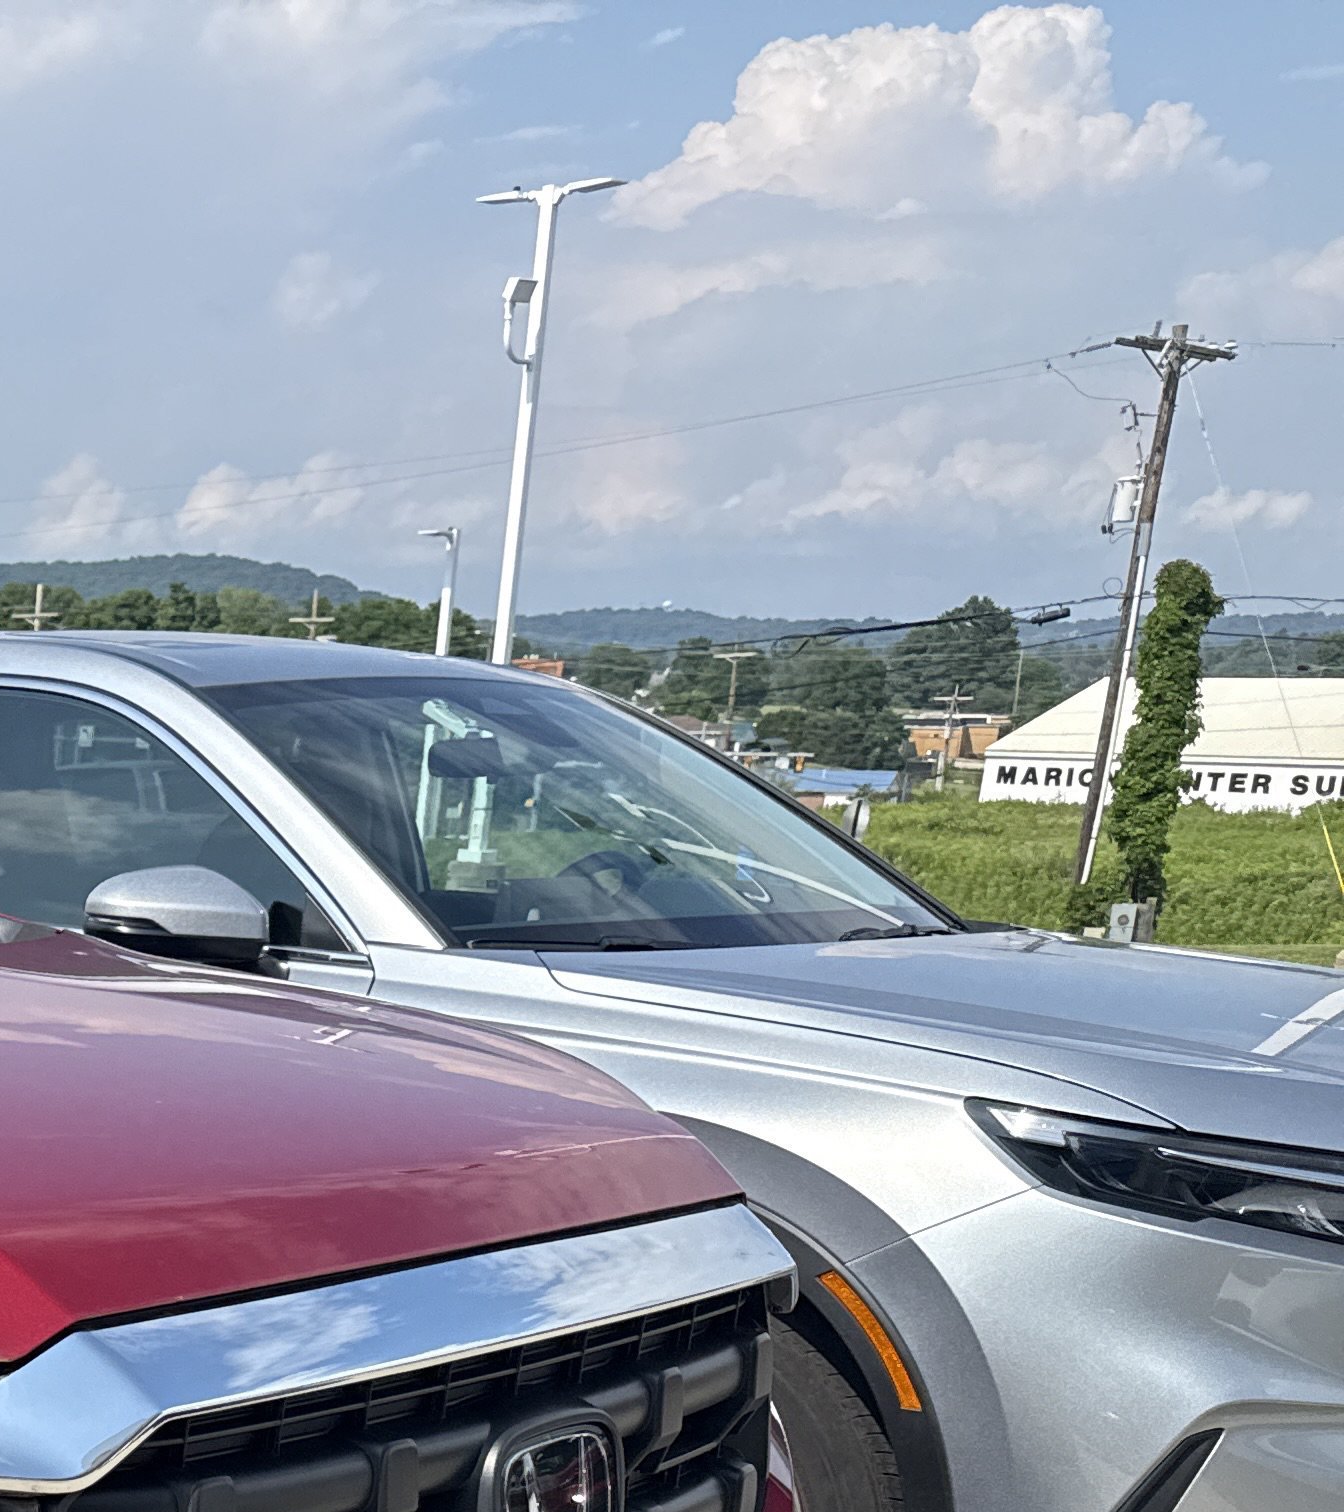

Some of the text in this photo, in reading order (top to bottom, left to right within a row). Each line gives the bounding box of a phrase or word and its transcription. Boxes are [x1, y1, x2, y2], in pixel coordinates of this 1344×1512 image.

[996, 765, 1344, 796] MARIO NTER SU
